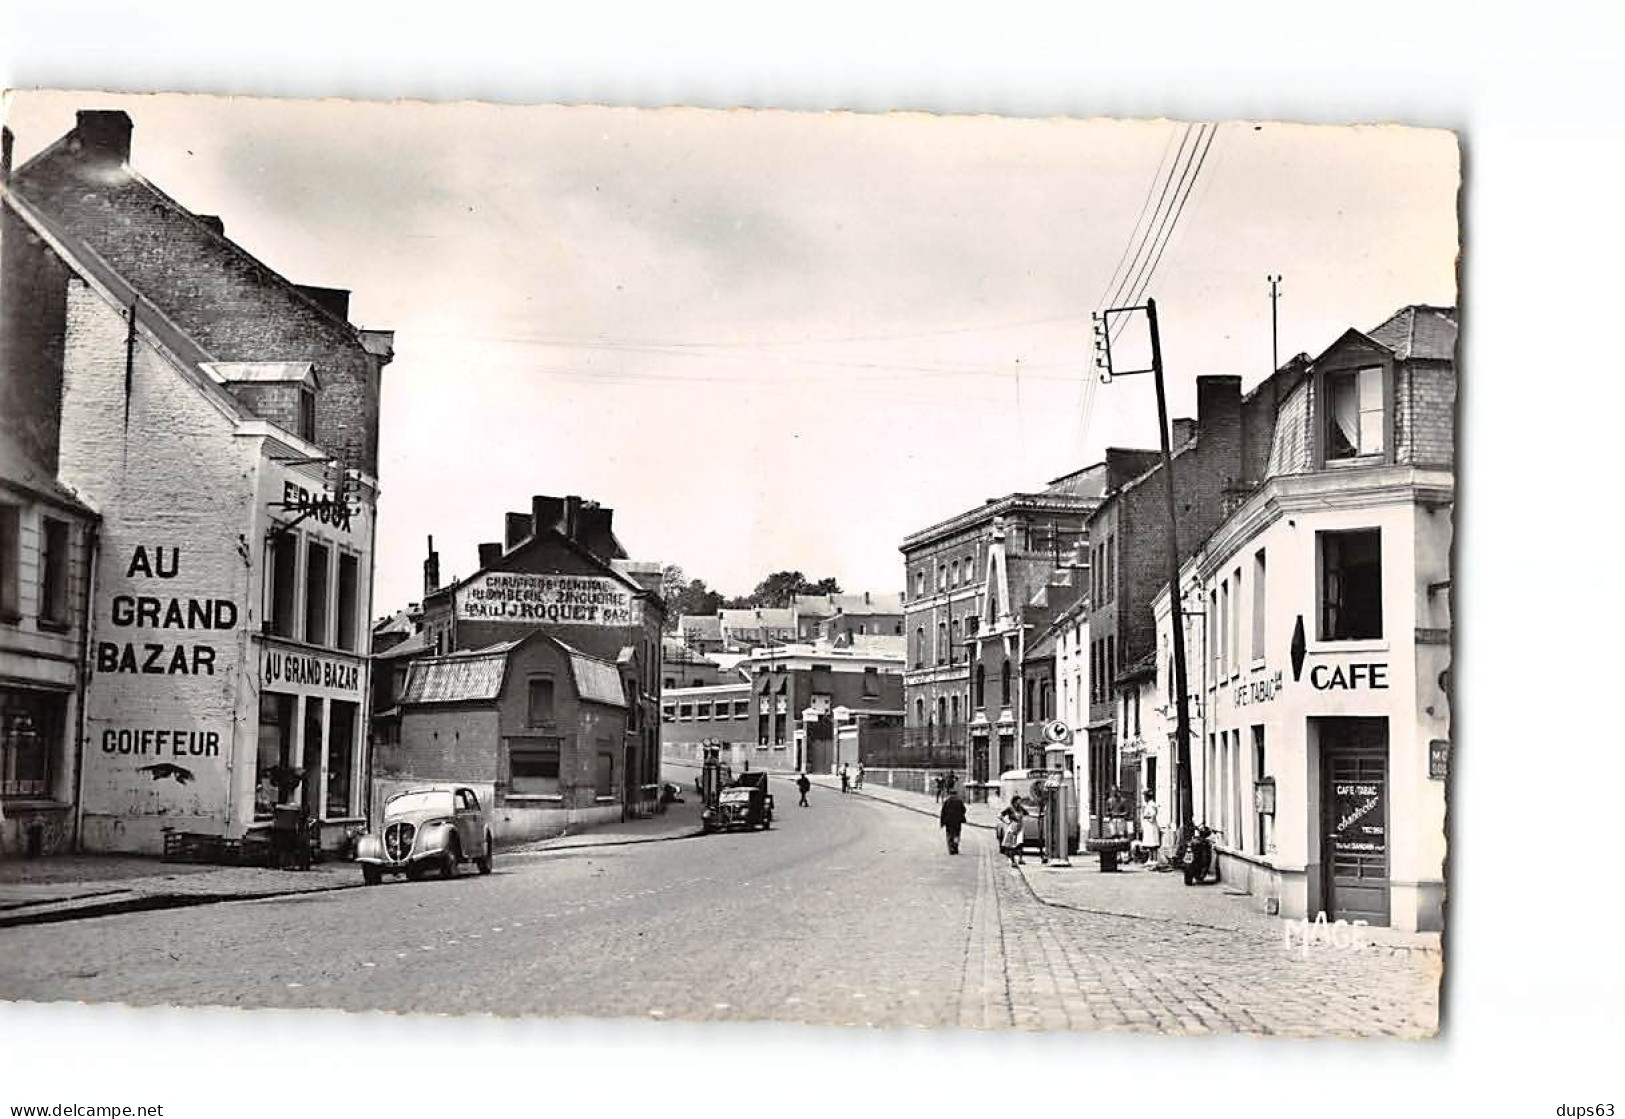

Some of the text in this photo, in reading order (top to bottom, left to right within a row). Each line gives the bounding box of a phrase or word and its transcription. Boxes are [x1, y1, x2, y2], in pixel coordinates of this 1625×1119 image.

[126, 545, 180, 579] AU
[112, 595, 238, 630] GRAND
[96, 641, 216, 676] BAZAR
[265, 652, 358, 691] AU GRAND BAZAR
[1310, 663, 1389, 690] CAFE
[102, 729, 219, 757] COIFFEUR
